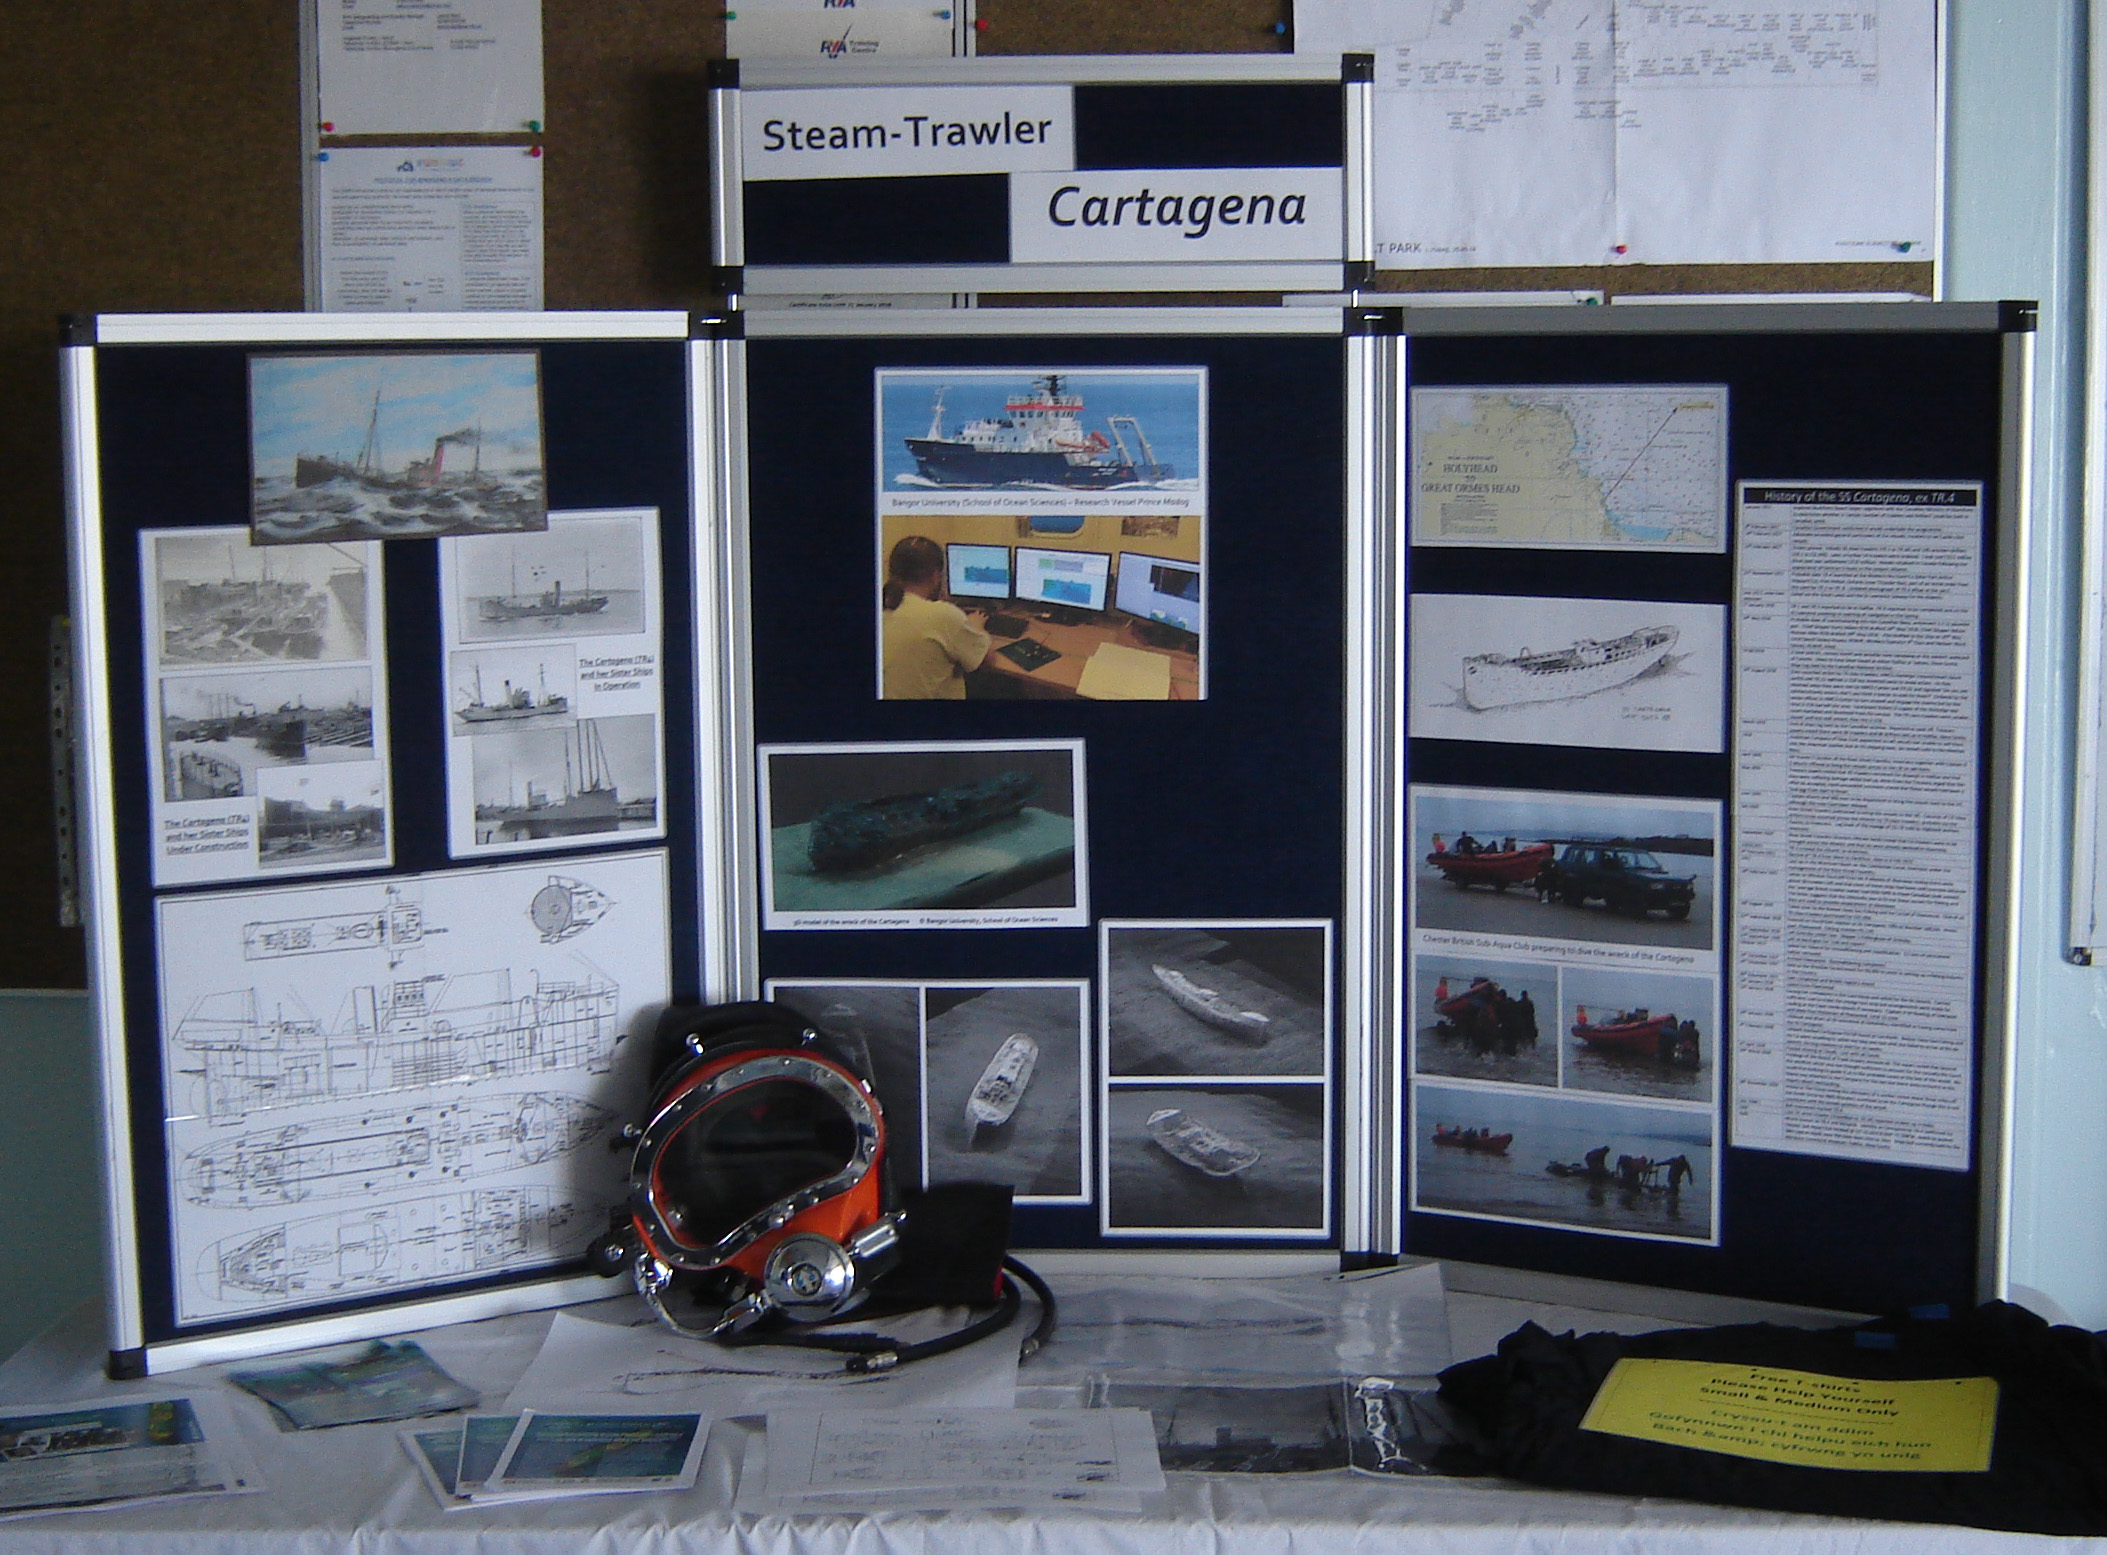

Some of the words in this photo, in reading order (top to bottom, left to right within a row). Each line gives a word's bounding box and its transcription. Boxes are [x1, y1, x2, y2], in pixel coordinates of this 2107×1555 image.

[763, 111, 1053, 152] Steam-Trawler
[1048, 185, 1307, 240] Cartagena
[1389, 242, 1422, 254] PARK
[1442, 463, 1498, 473] HOLYHEAD
[1421, 483, 1453, 493] GREAT
[1491, 484, 1521, 494] HEAD
[892, 498, 920, 510] Bangor
[921, 497, 960, 510] University
[993, 498, 1002, 508] of
[1003, 498, 1028, 508] Ocean
[1074, 497, 1110, 507] Research
[1112, 497, 1136, 507] Vessel
[1137, 497, 1161, 507] Prince
[1764, 491, 1803, 504] History
[1804, 491, 1816, 502] of
[1818, 491, 1837, 503] the
[1838, 492, 1851, 503] SS
[1853, 492, 1913, 506] Cartagena,
[1915, 494, 1929, 504] ex
[579, 658, 594, 668] The
[595, 656, 633, 668] Cartagena
[581, 671, 595, 680] and
[597, 670, 609, 679] her
[610, 668, 632, 678] Sister
[602, 680, 641, 692] Operation
[165, 819, 180, 829] The
[182, 816, 226, 828] Cartagena
[166, 833, 182, 843] and
[184, 832, 198, 841] her
[199, 829, 225, 840] Sister
[167, 844, 194, 855] Under
[195, 841, 249, 854] Construction
[878, 917, 910, 926] Cartagena
[926, 917, 948, 926] Bangor
[982, 916, 1003, 924] School
[1012, 915, 1030, 924] Ocean
[1031, 914, 1058, 923] Sciences
[1422, 934, 1450, 943] Chester
[1451, 936, 1475, 946] British
[1513, 941, 1530, 951] Club
[1531, 944, 1567, 956] preparing
[1577, 946, 1592, 956] dive
[1593, 948, 1607, 957] the
[1608, 949, 1630, 959] wreck
[1641, 951, 1654, 961] the
[1655, 952, 1695, 965] Cartagena
[1750, 1373, 1788, 1384] Free
[1711, 1378, 1769, 1391] Please
[1773, 1386, 1815, 1399] Help
[1821, 1392, 1895, 1406] Yourself
[1700, 1387, 1749, 1399] Small
[1755, 1394, 1769, 1402] &
[1774, 1397, 1851, 1413] Medium
[1857, 1407, 1899, 1417] Only
[1648, 1411, 1744, 1431] Gofynnwn
[1761, 1429, 1787, 1438] chi
[1792, 1433, 1846, 1445] helpu
[1792, 1422, 1822, 1431] am
[1826, 1425, 1875, 1436] ddim
[1653, 1422, 1697, 1436] Bach
[1770, 1442, 1846, 1458] cyfrwng
[1850, 1451, 1875, 1459] yn
